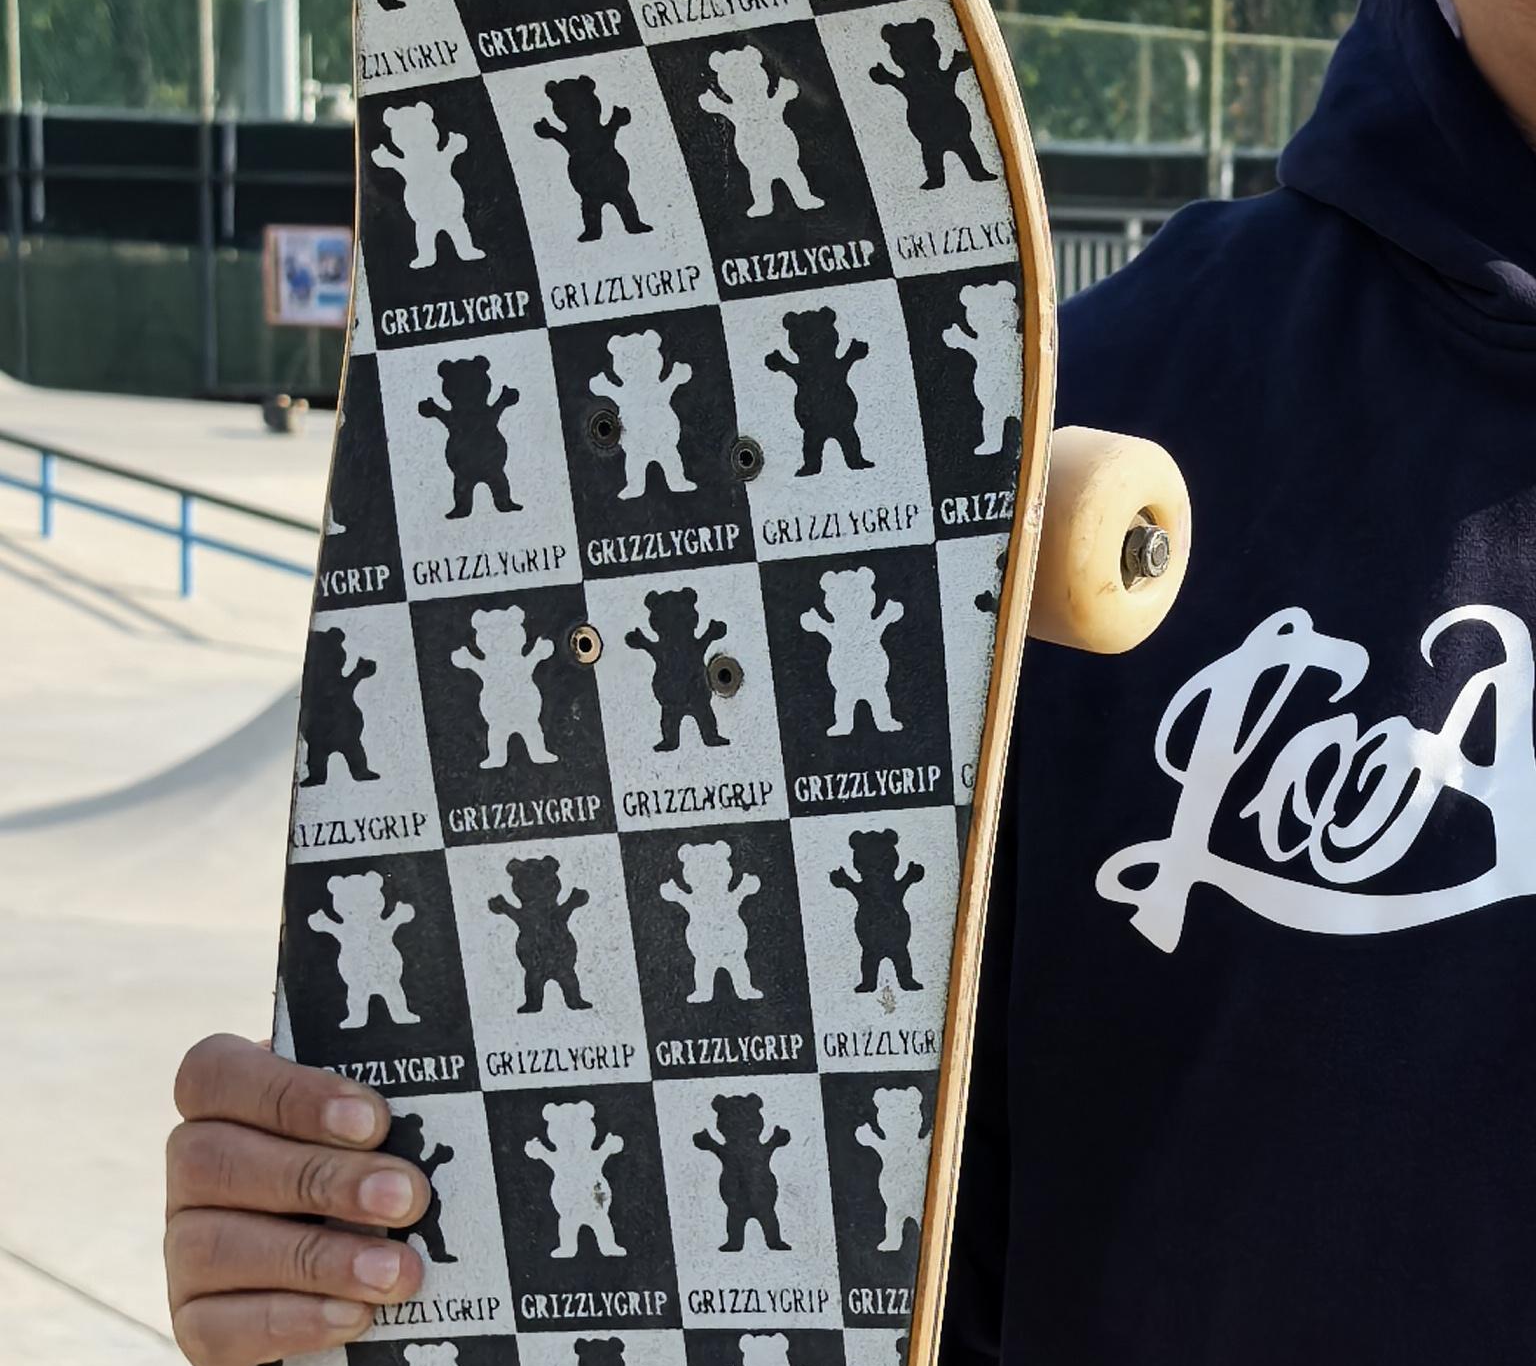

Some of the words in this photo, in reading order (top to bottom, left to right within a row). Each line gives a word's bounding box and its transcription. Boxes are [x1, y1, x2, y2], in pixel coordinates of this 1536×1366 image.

[478, 8, 622, 57] GRIZZLYGRIP
[722, 240, 875, 287] GRIZZLYGRIP
[551, 266, 700, 310] GRIZZLYGRIP
[382, 291, 529, 335] GRIZZLYGRIP
[587, 523, 740, 566] GRIZZLYGRIP
[763, 505, 919, 546] GRIZZLYGRIP
[413, 546, 566, 585] GRIZZLYGRIP
[623, 781, 773, 817] GRIZZLYGRIP
[795, 765, 941, 803] GRIZZLYGRIP
[293, 812, 427, 850] IZZLYGRIP
[449, 795, 600, 833] GRIZZLYGRIP
[487, 1044, 635, 1076] GRIZZLYGRIP
[656, 1034, 803, 1066] GRIZZLYGRIP
[521, 1291, 668, 1319] GRIZZLYGRIP
[688, 1289, 829, 1315] GRIZZLYGRIP
